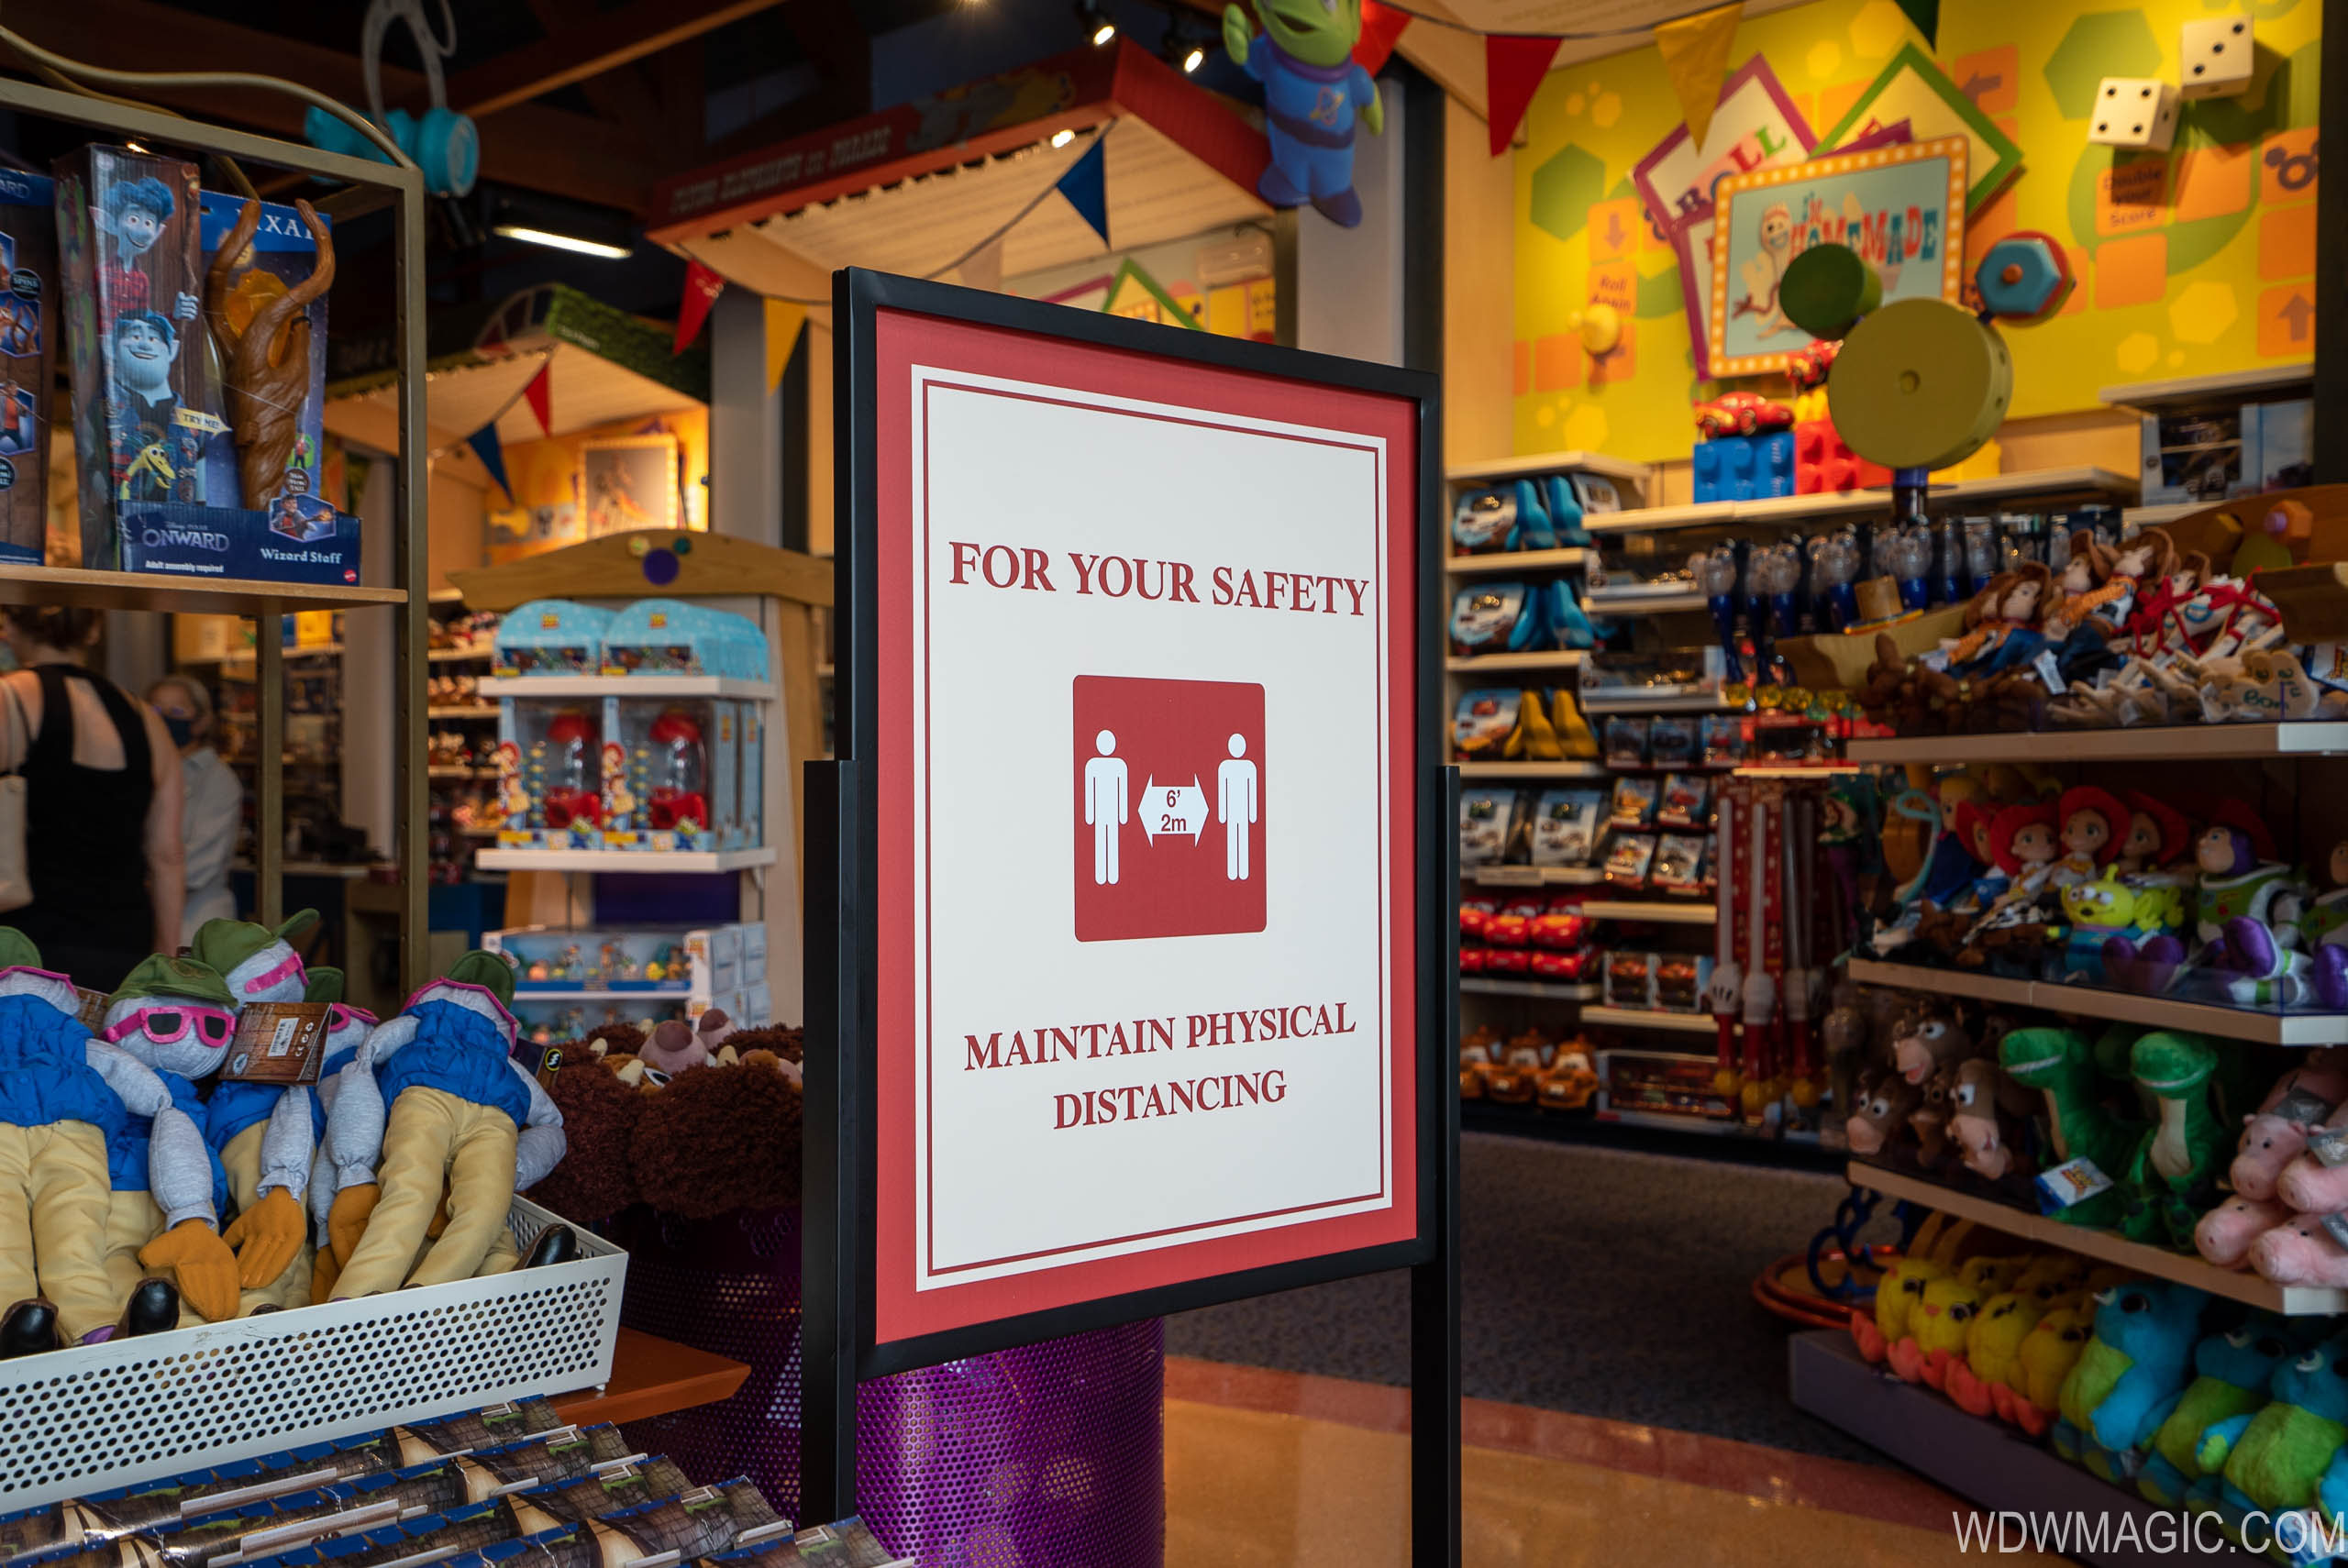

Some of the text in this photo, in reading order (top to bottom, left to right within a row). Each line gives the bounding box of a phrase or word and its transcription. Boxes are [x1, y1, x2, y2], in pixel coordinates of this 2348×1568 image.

[2110, 208, 2156, 228] Score
[184, 414, 201, 425] TRY
[142, 528, 230, 552] ONWARD
[260, 547, 343, 565] Wizard Staff
[948, 541, 1369, 616] FOR YOUR SAFETY
[1160, 813, 1187, 832] 2m
[963, 1001, 1357, 1071] MAINTAIN PHYSICAL
[1053, 1069, 1288, 1130] DISTANCING
